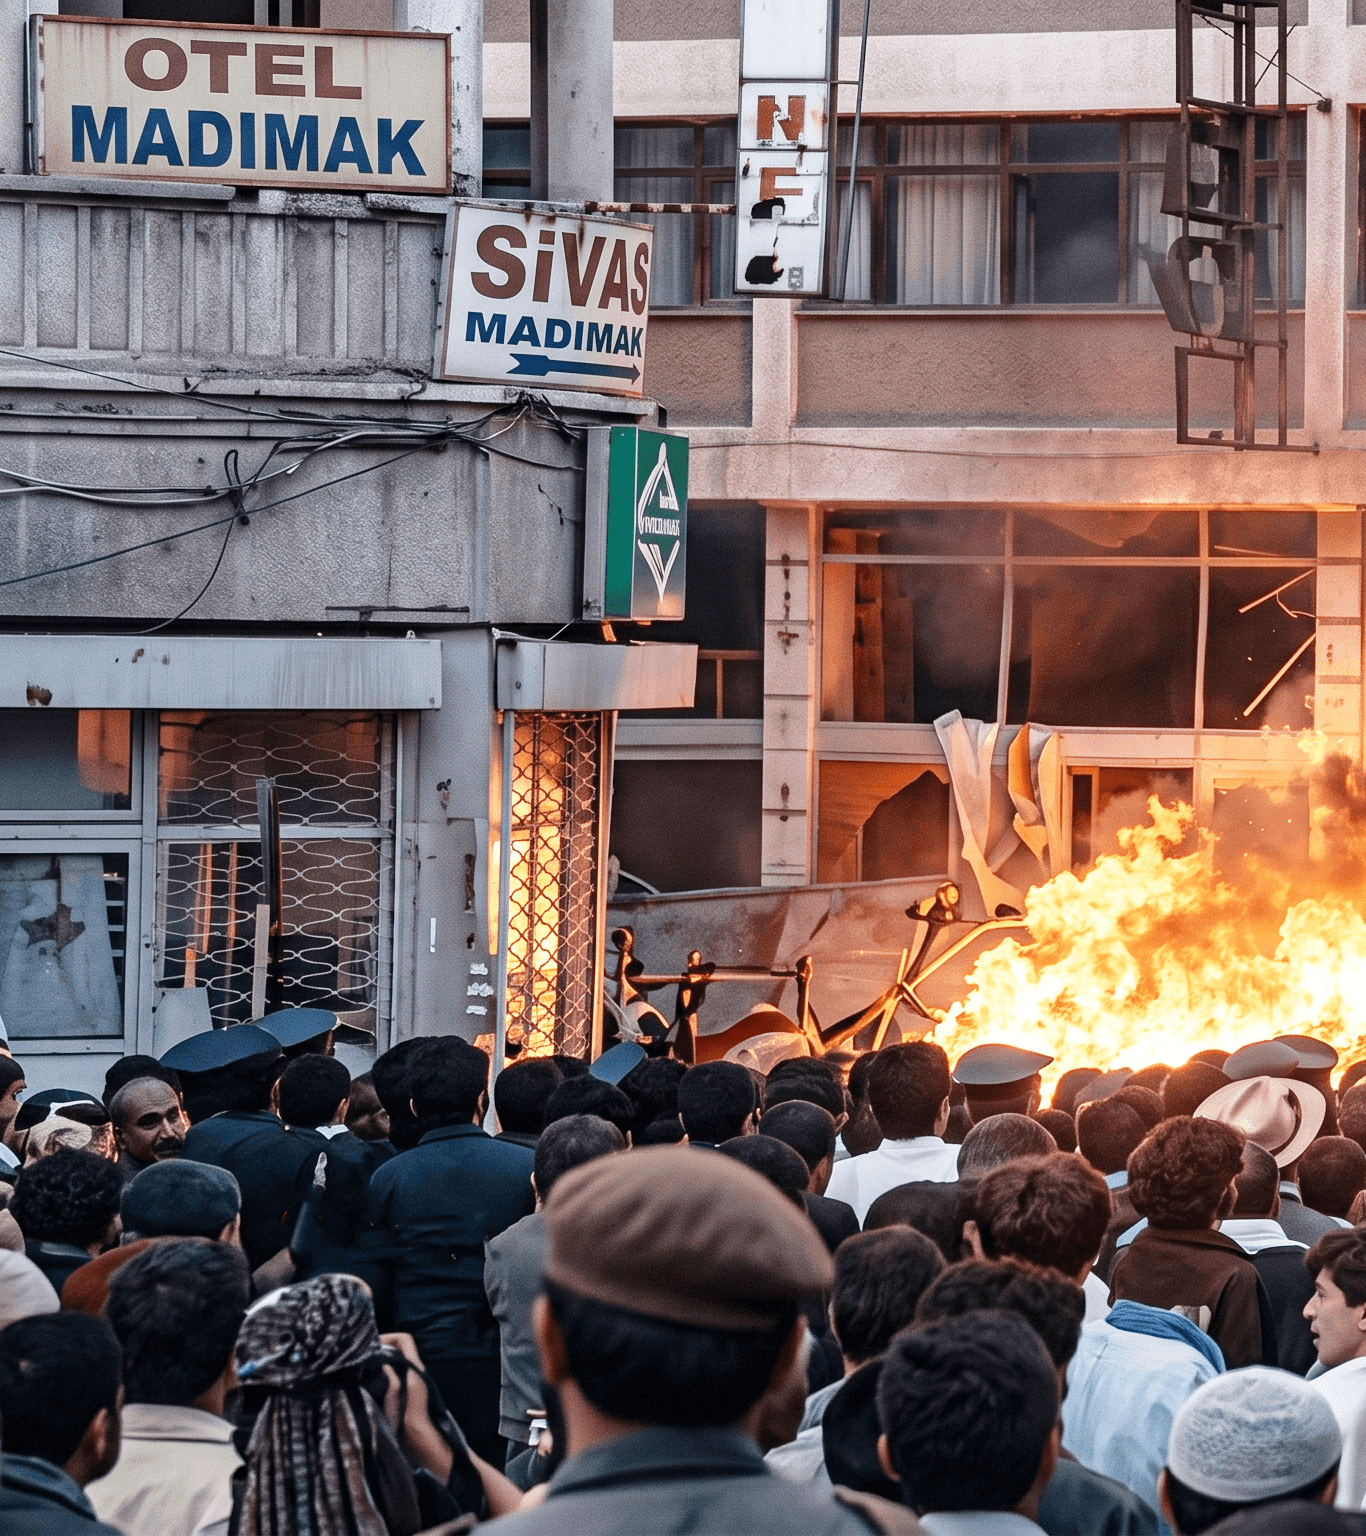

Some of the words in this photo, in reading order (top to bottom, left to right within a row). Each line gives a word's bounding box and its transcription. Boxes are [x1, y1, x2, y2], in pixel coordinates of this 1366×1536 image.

[124, 38, 362, 100] OTEL
[71, 105, 427, 176] MADIMAK
[465, 312, 644, 357] MADIMAK
